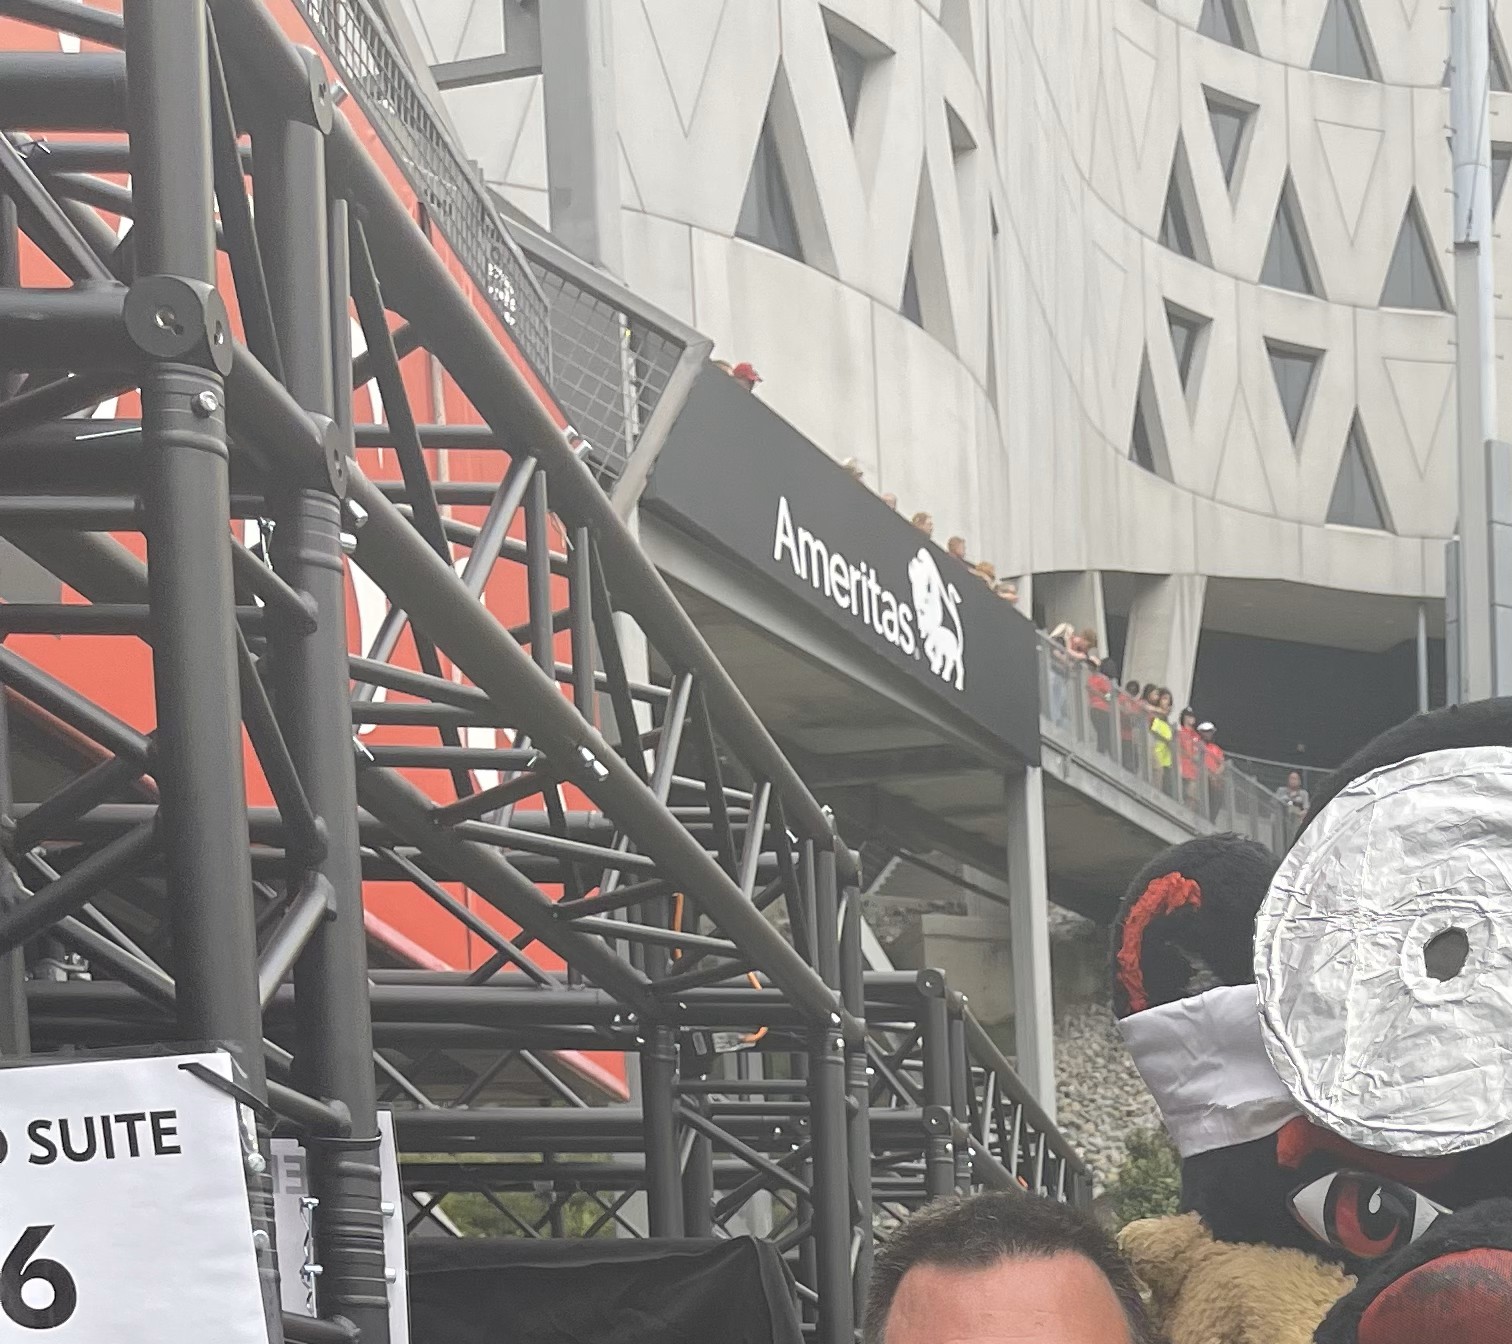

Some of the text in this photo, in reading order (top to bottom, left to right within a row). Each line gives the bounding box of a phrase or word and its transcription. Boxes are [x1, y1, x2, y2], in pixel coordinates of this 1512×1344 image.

[774, 496, 916, 655] Ameritas
[27, 1110, 181, 1165] SUITE
[0, 1224, 77, 1330] 6
